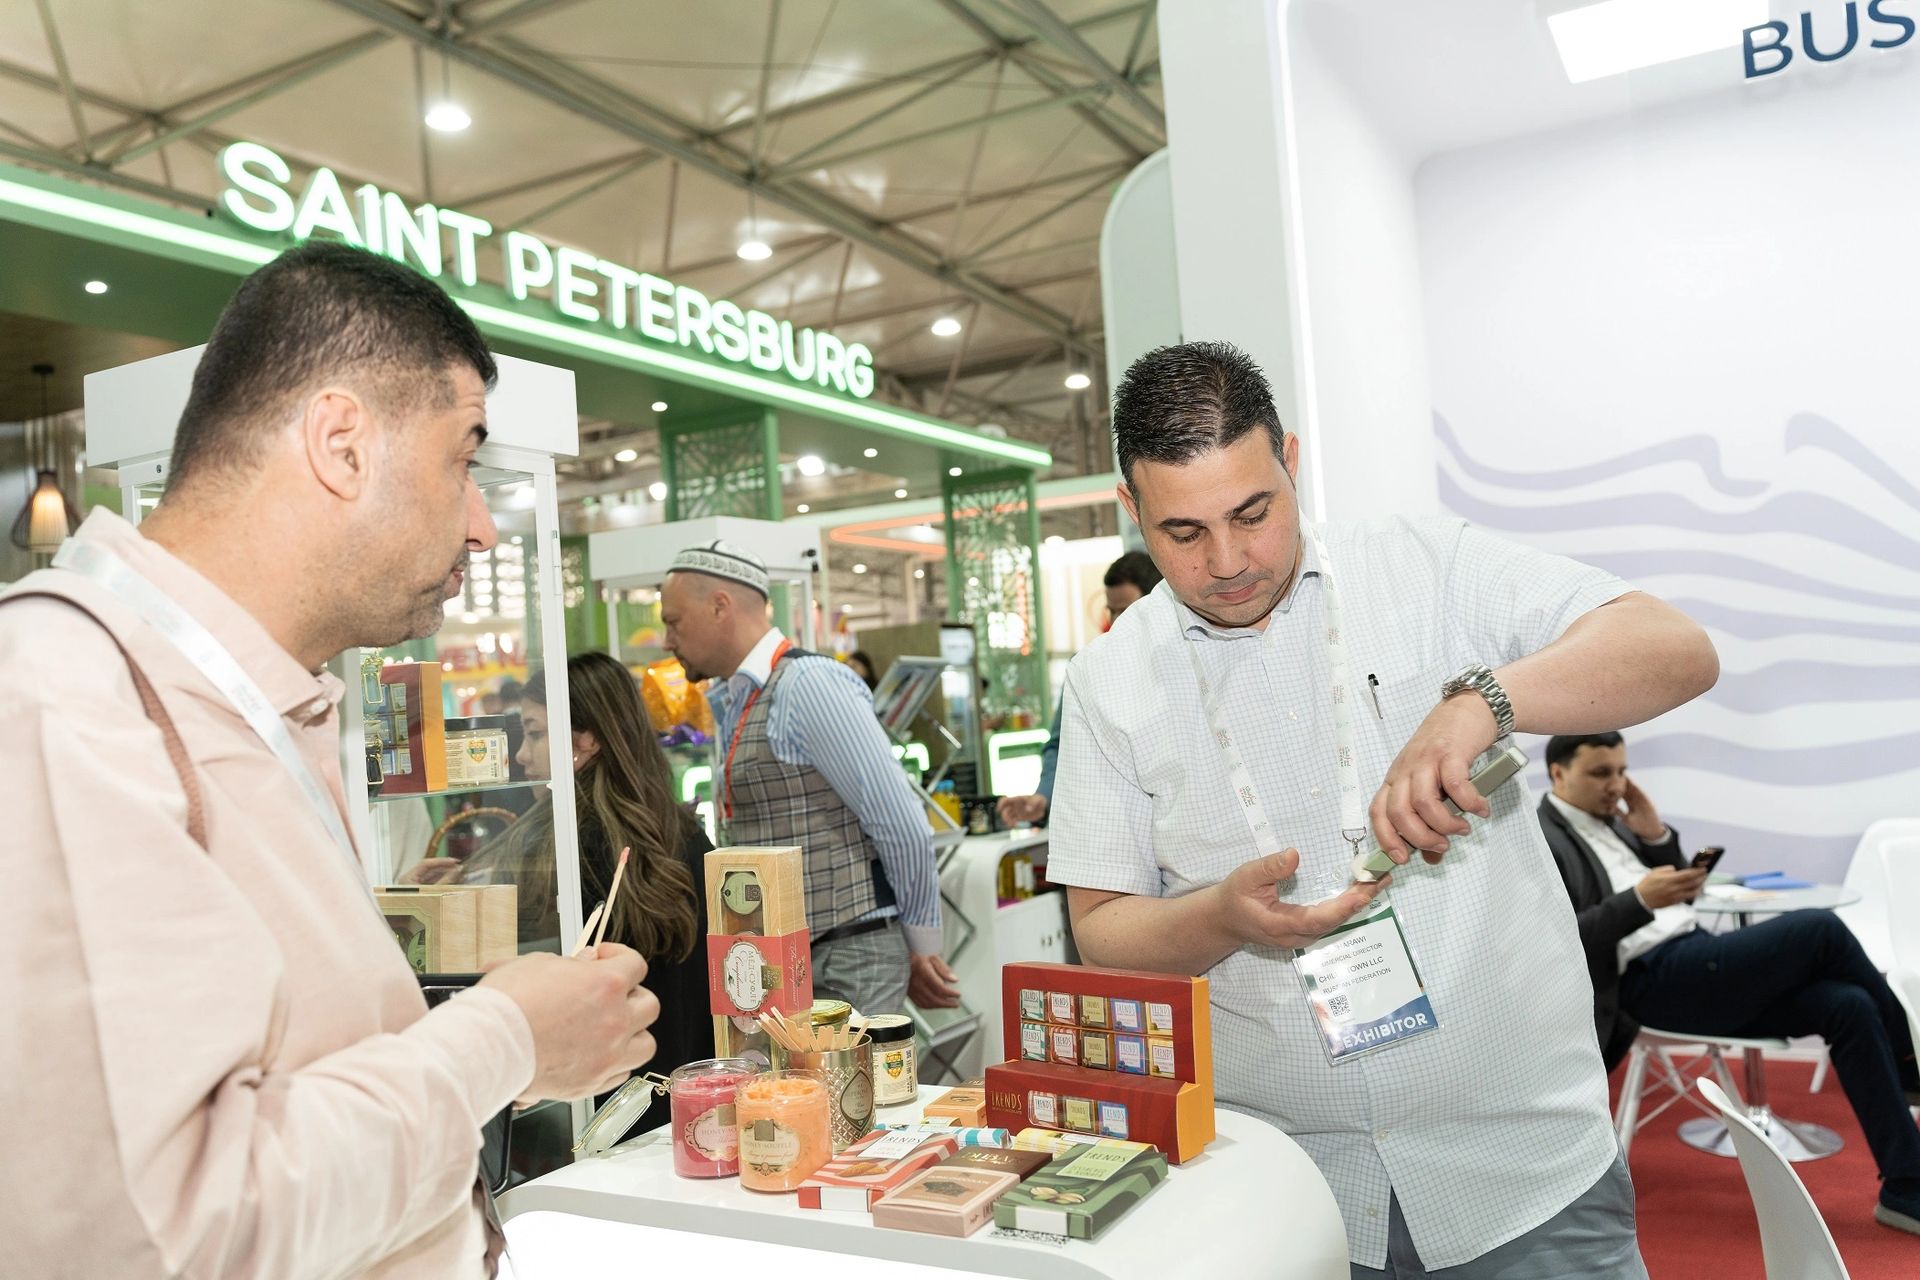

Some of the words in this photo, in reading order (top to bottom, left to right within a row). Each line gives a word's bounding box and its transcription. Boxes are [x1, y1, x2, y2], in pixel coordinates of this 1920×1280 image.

[1743, 0, 1916, 78] BUS
[220, 141, 492, 287] SAINT
[506, 230, 876, 399] PETERSBURG
[1352, 942, 1384, 957] DIRECTOR
[1368, 956, 1384, 967] LLC
[1322, 981, 1351, 995] RUSAN
[1351, 967, 1392, 985] FEDERATION
[1342, 1012, 1428, 1049] EXHIBITOR
[991, 1091, 1022, 1110] TRENDS
[1084, 1151, 1127, 1163] TRENDS
